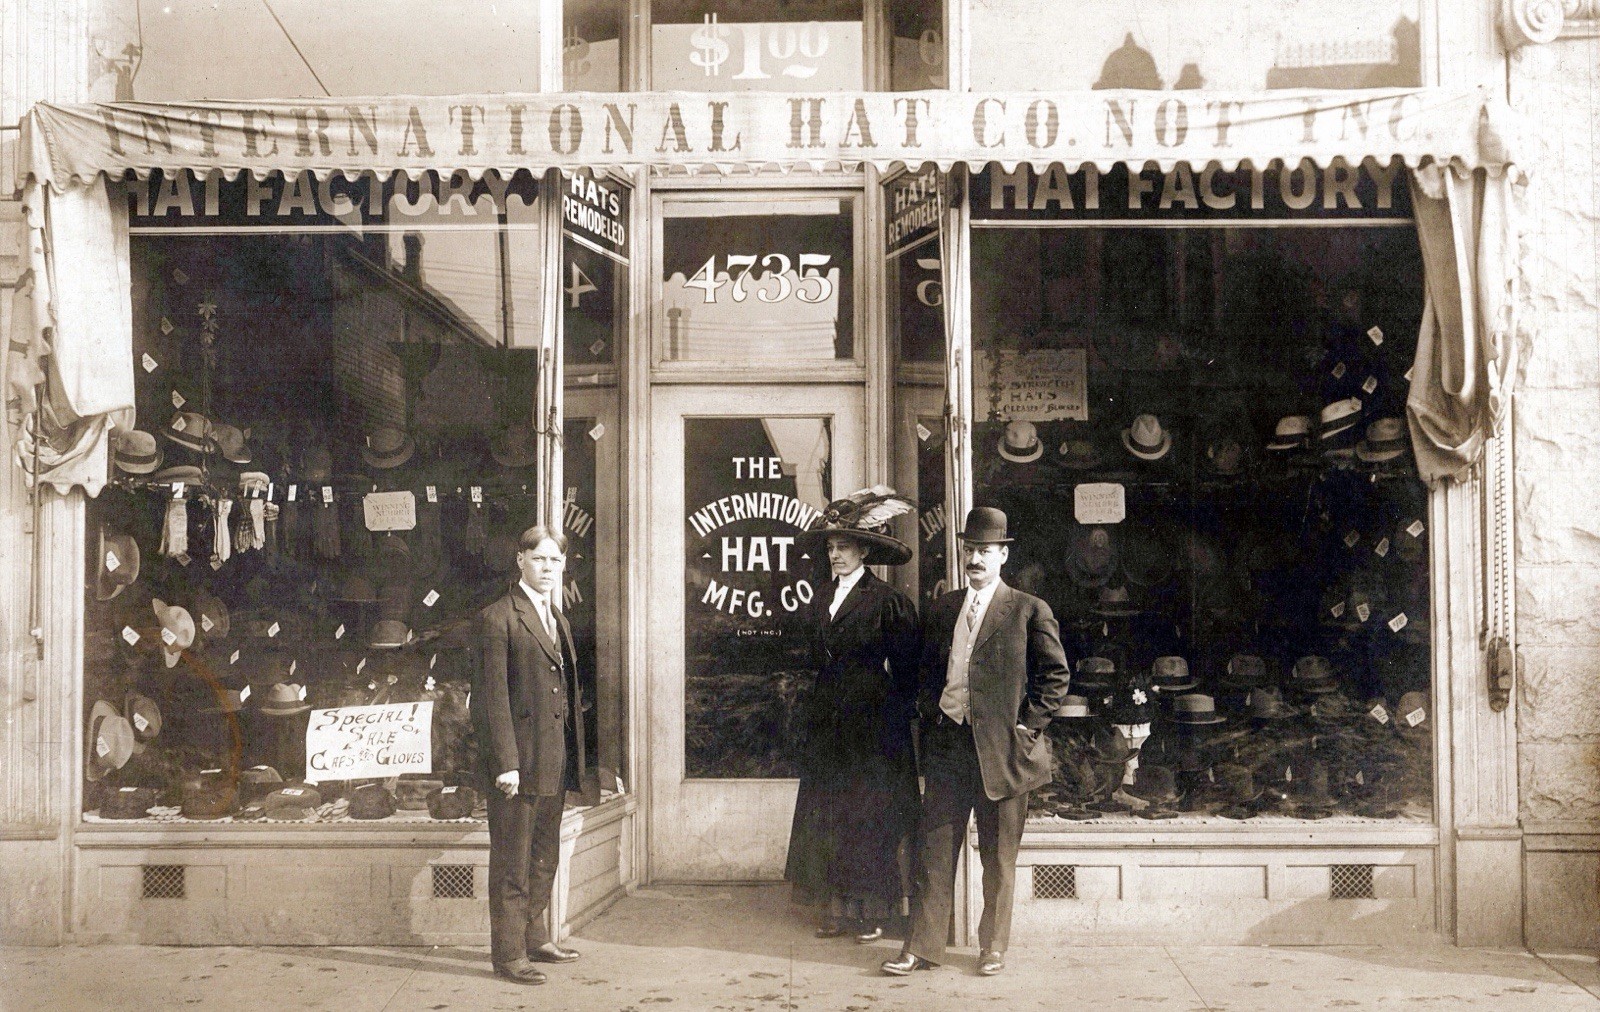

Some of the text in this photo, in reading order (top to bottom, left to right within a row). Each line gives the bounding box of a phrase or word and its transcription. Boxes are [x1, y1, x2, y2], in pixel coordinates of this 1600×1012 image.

[96, 101, 741, 157] INTERNATIONAL
[786, 97, 931, 149] HAT
[971, 98, 1077, 149] CO.
[1103, 98, 1247, 149] NOT
[124, 168, 511, 216] HAT FACTORY
[571, 172, 620, 216] HATS
[895, 169, 936, 213] HATS
[990, 155, 1398, 209] HAT FACTORY
[563, 194, 625, 246] REMODELED
[683, 253, 833, 304] 4735
[1010, 391, 1058, 402] HATS
[732, 456, 782, 479] THE
[721, 536, 795, 572] HAT
[701, 579, 772, 618] MFG.
[736, 628, 782, 638] (NOT INC.)
[342, 725, 398, 750] SALE
[310, 749, 355, 771] CAPS
[376, 747, 425, 766] GLOVES
